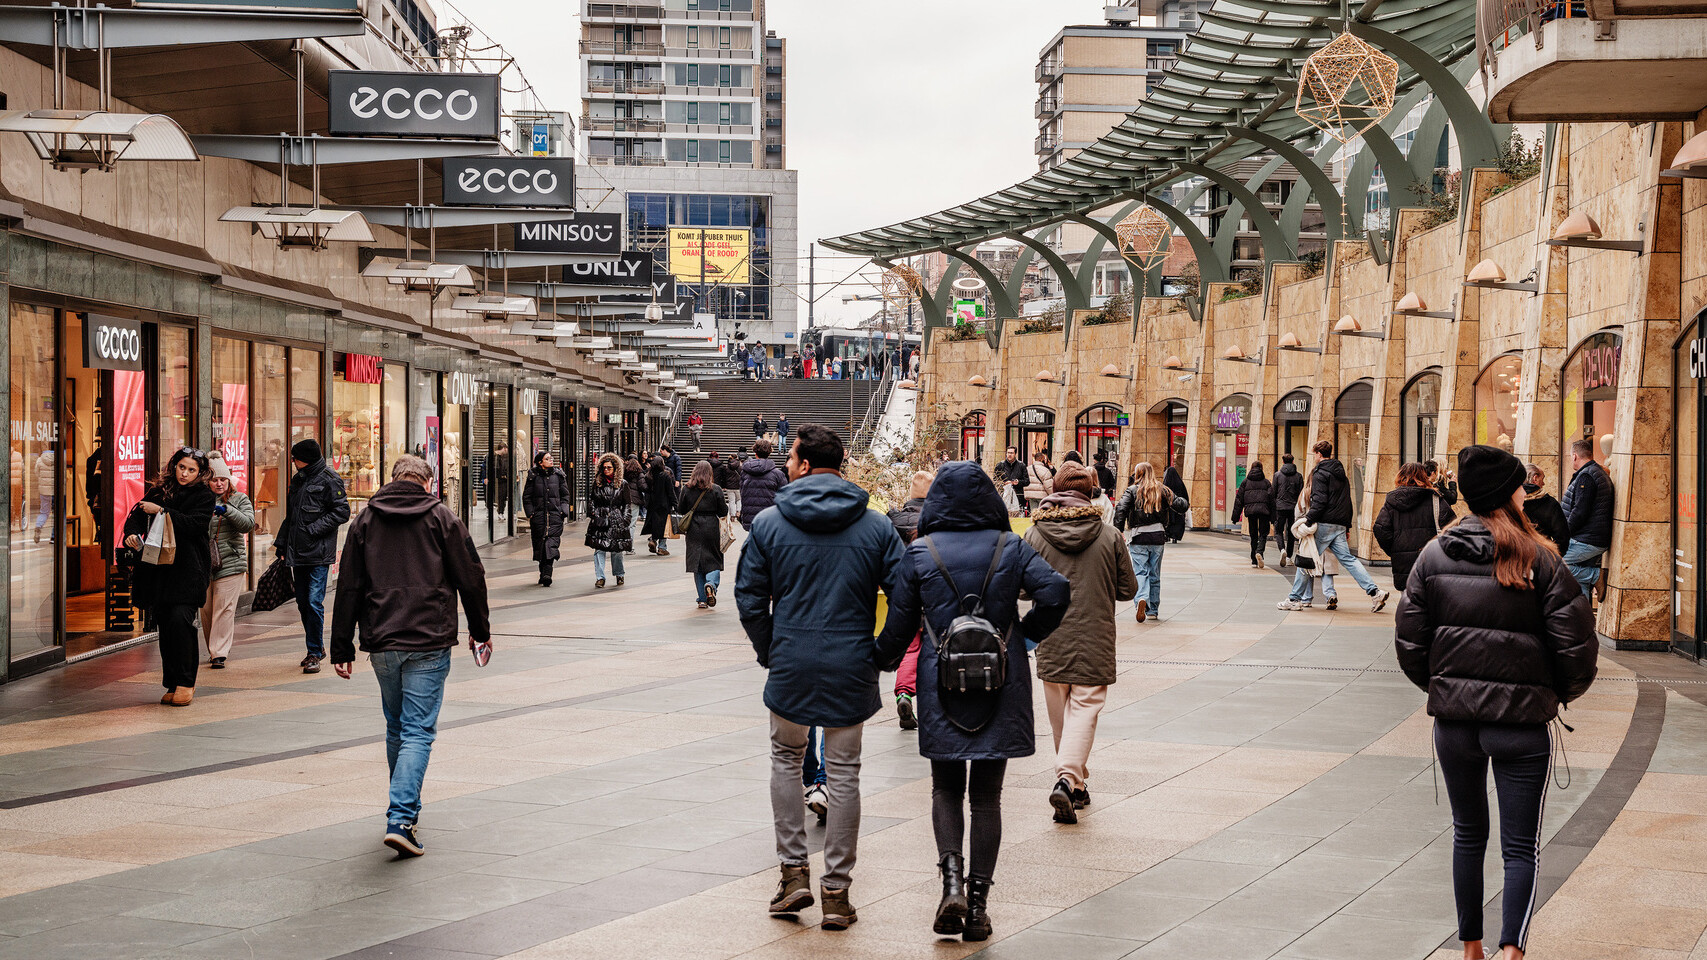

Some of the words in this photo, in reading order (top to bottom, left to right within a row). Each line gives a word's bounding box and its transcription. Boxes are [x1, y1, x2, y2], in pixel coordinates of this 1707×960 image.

[350, 86, 478, 121] ecco
[458, 167, 557, 194] ecco
[687, 241, 698, 249] ALS
[717, 250, 739, 258] ROOD?
[573, 260, 642, 277] ONLY
[100, 325, 140, 362] ecco
[11, 420, 35, 441] INAL
[36, 421, 59, 442] SALE
[118, 435, 145, 460] SALE
[225, 440, 244, 461] SALE
[1678, 493, 1696, 518] SALE
